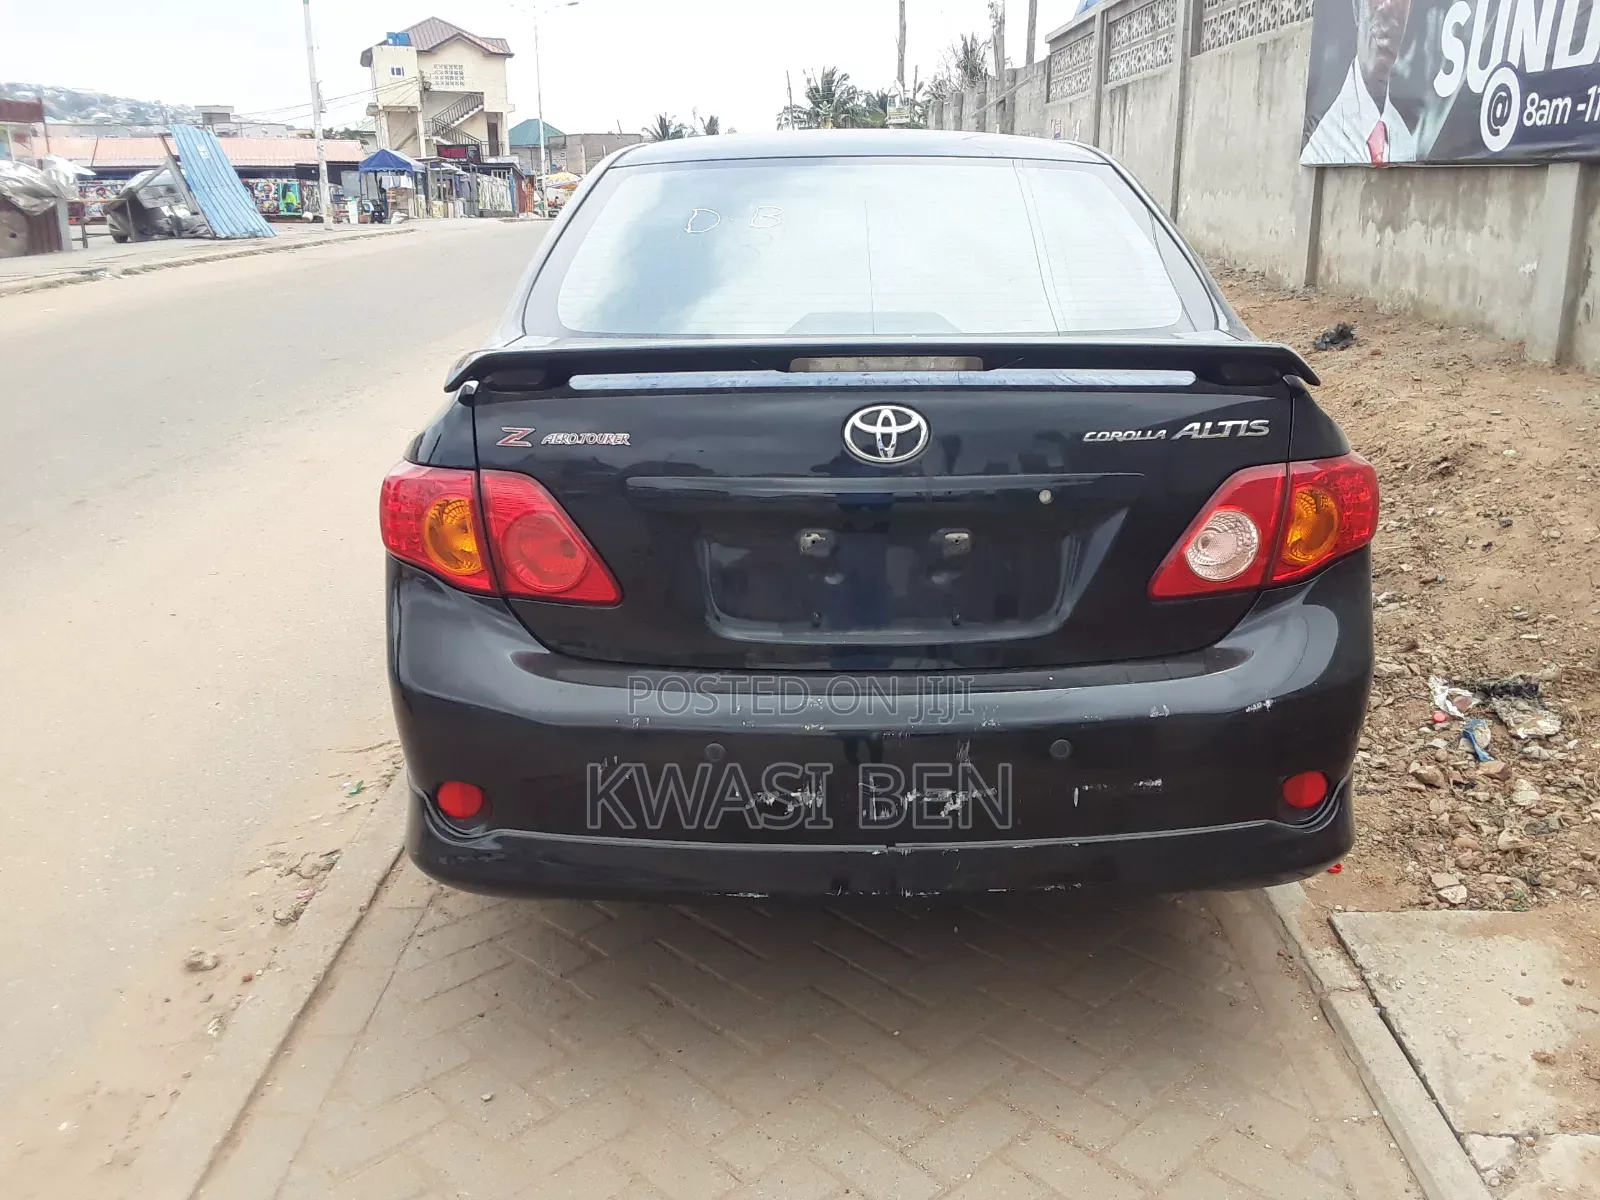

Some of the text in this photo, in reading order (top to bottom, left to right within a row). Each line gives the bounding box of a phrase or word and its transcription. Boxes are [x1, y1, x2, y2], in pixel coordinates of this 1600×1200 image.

[1433, 0, 1600, 97] SUND
[1523, 92, 1572, 127] 8am
[496, 426, 536, 447] Z
[1083, 419, 1270, 443] COROLLA ALTIS
